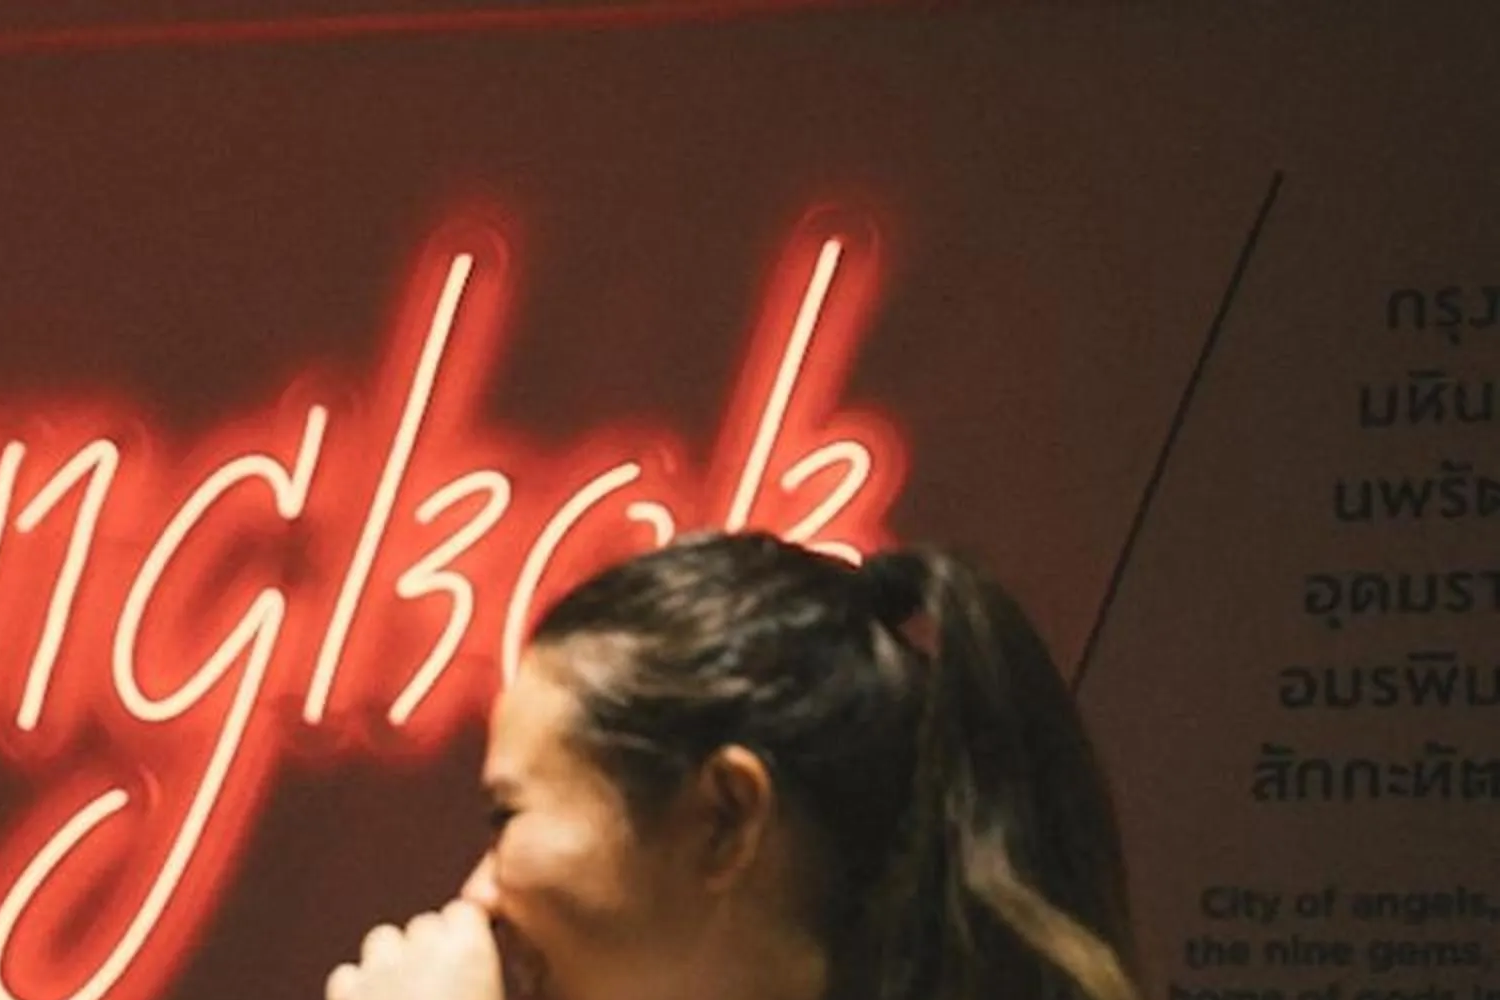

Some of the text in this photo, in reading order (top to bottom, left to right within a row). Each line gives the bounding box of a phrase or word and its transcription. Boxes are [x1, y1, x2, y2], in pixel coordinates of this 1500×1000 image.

[1200, 886, 1282, 924] City
[1296, 884, 1337, 918] of
[1186, 935, 1250, 969] the
[1264, 933, 1355, 967] nine
